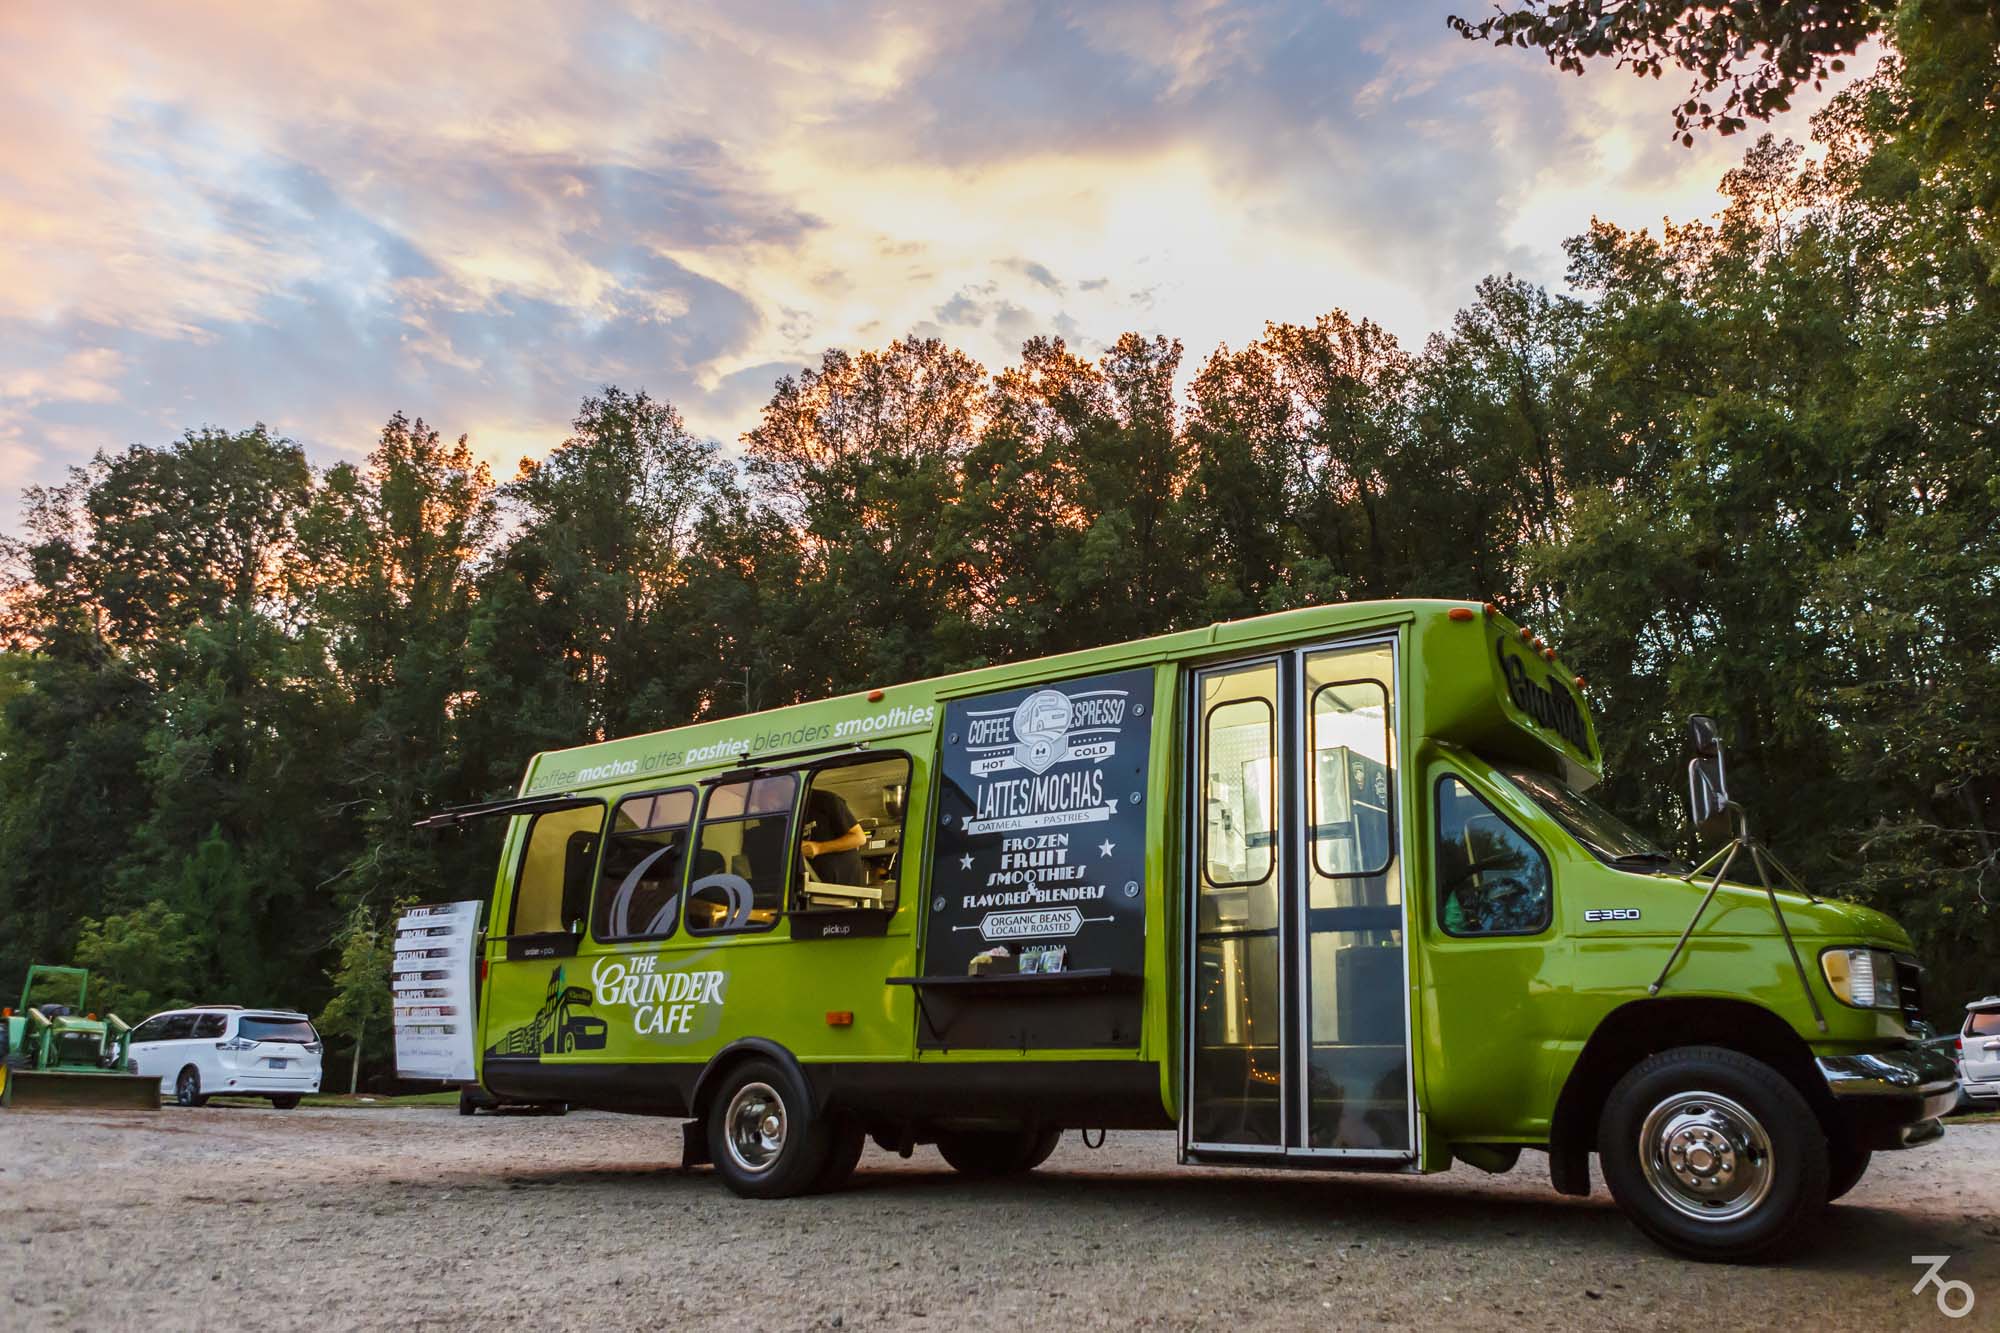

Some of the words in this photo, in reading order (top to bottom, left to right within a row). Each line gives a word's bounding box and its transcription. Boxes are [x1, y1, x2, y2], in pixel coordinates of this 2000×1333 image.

[968, 717, 1011, 744] COFFEE
[577, 759, 638, 782] mochas
[641, 751, 684, 770] lattes
[685, 738, 750, 767] pastries
[753, 722, 831, 751] blenders
[834, 705, 934, 737] smoothies
[982, 760, 1005, 771] HOT
[1074, 745, 1107, 757] COLD
[976, 769, 1103, 819] LATTES/MOCHAS
[978, 820, 1022, 832] OATMEAL
[1044, 813, 1090, 824] PASTRIES
[1003, 833, 1069, 852] FROZEN
[1001, 849, 1068, 869] FRUIT
[986, 865, 1086, 887] SMOOTHIES
[963, 891, 1030, 908] FLAVORED
[1035, 885, 1106, 903] BLENDERS
[991, 914, 1035, 926] ORGANIC
[1040, 912, 1072, 923] BEANS
[1585, 909, 1640, 921] E350
[991, 926, 1028, 935] LOCALLY
[1030, 923, 1070, 933] ROASTED
[1021, 944, 1067, 954] AROLINA
[630, 955, 657, 973] THE
[592, 956, 724, 1007] GRINDER
[634, 1005, 695, 1034] CAFE
